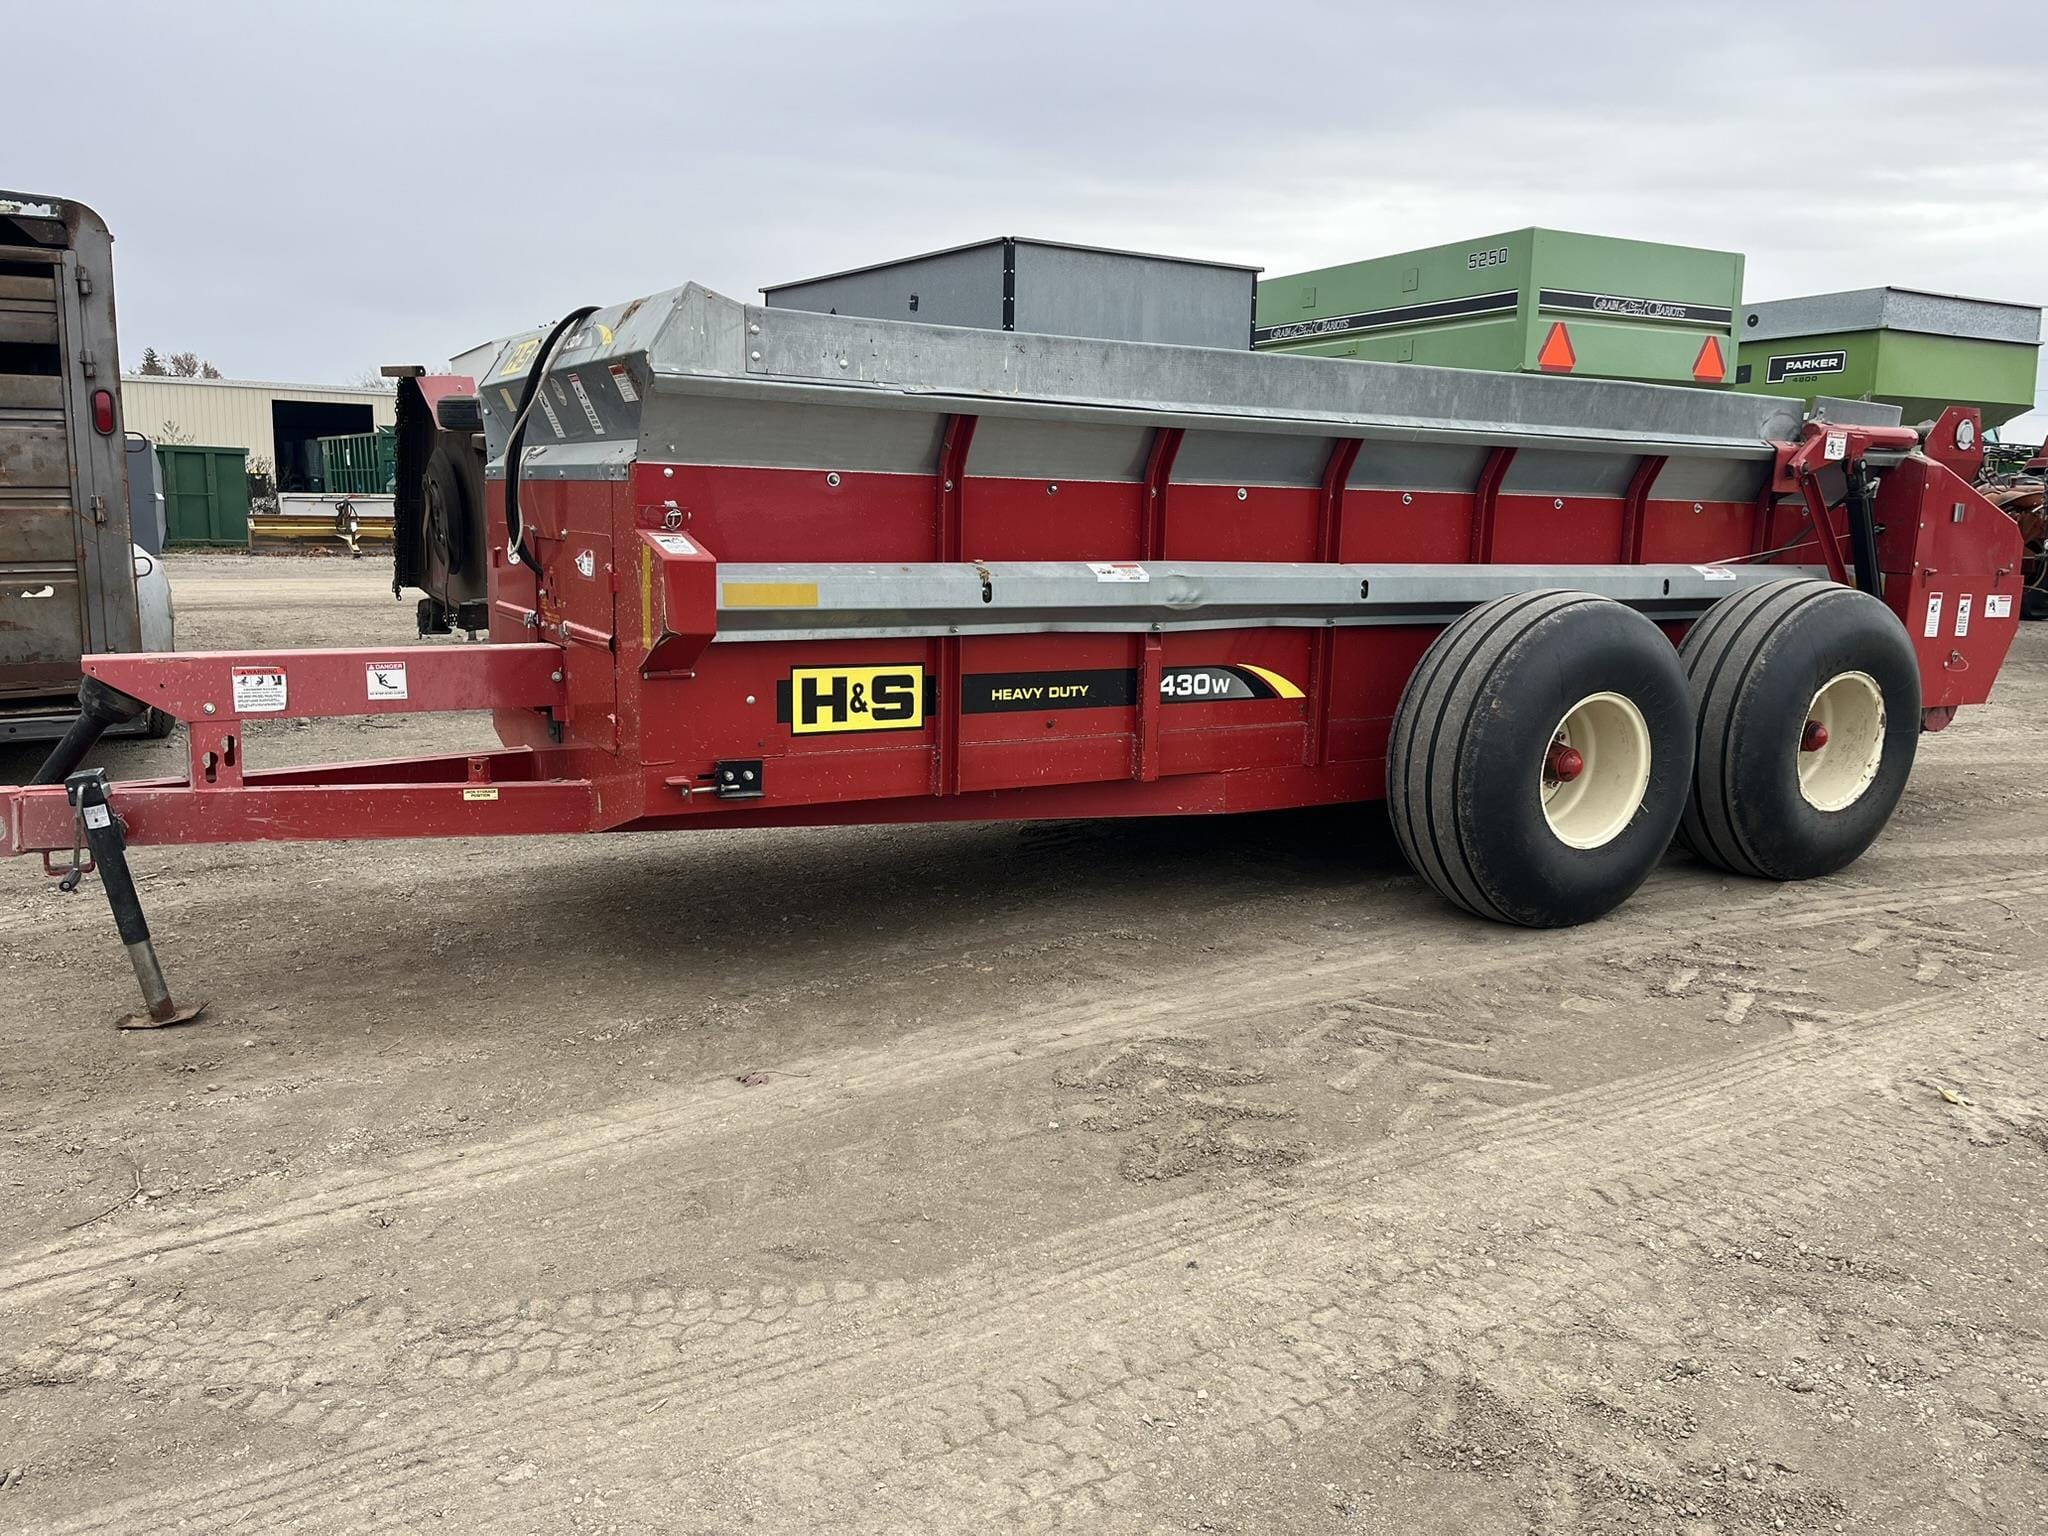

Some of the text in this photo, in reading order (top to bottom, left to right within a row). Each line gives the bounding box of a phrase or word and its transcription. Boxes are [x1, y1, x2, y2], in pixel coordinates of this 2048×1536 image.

[1468, 247, 1508, 270] 5250
[1785, 358, 1838, 370] PARKER
[801, 674, 914, 724] H&S
[991, 685, 1089, 701] HEAVY DUTY
